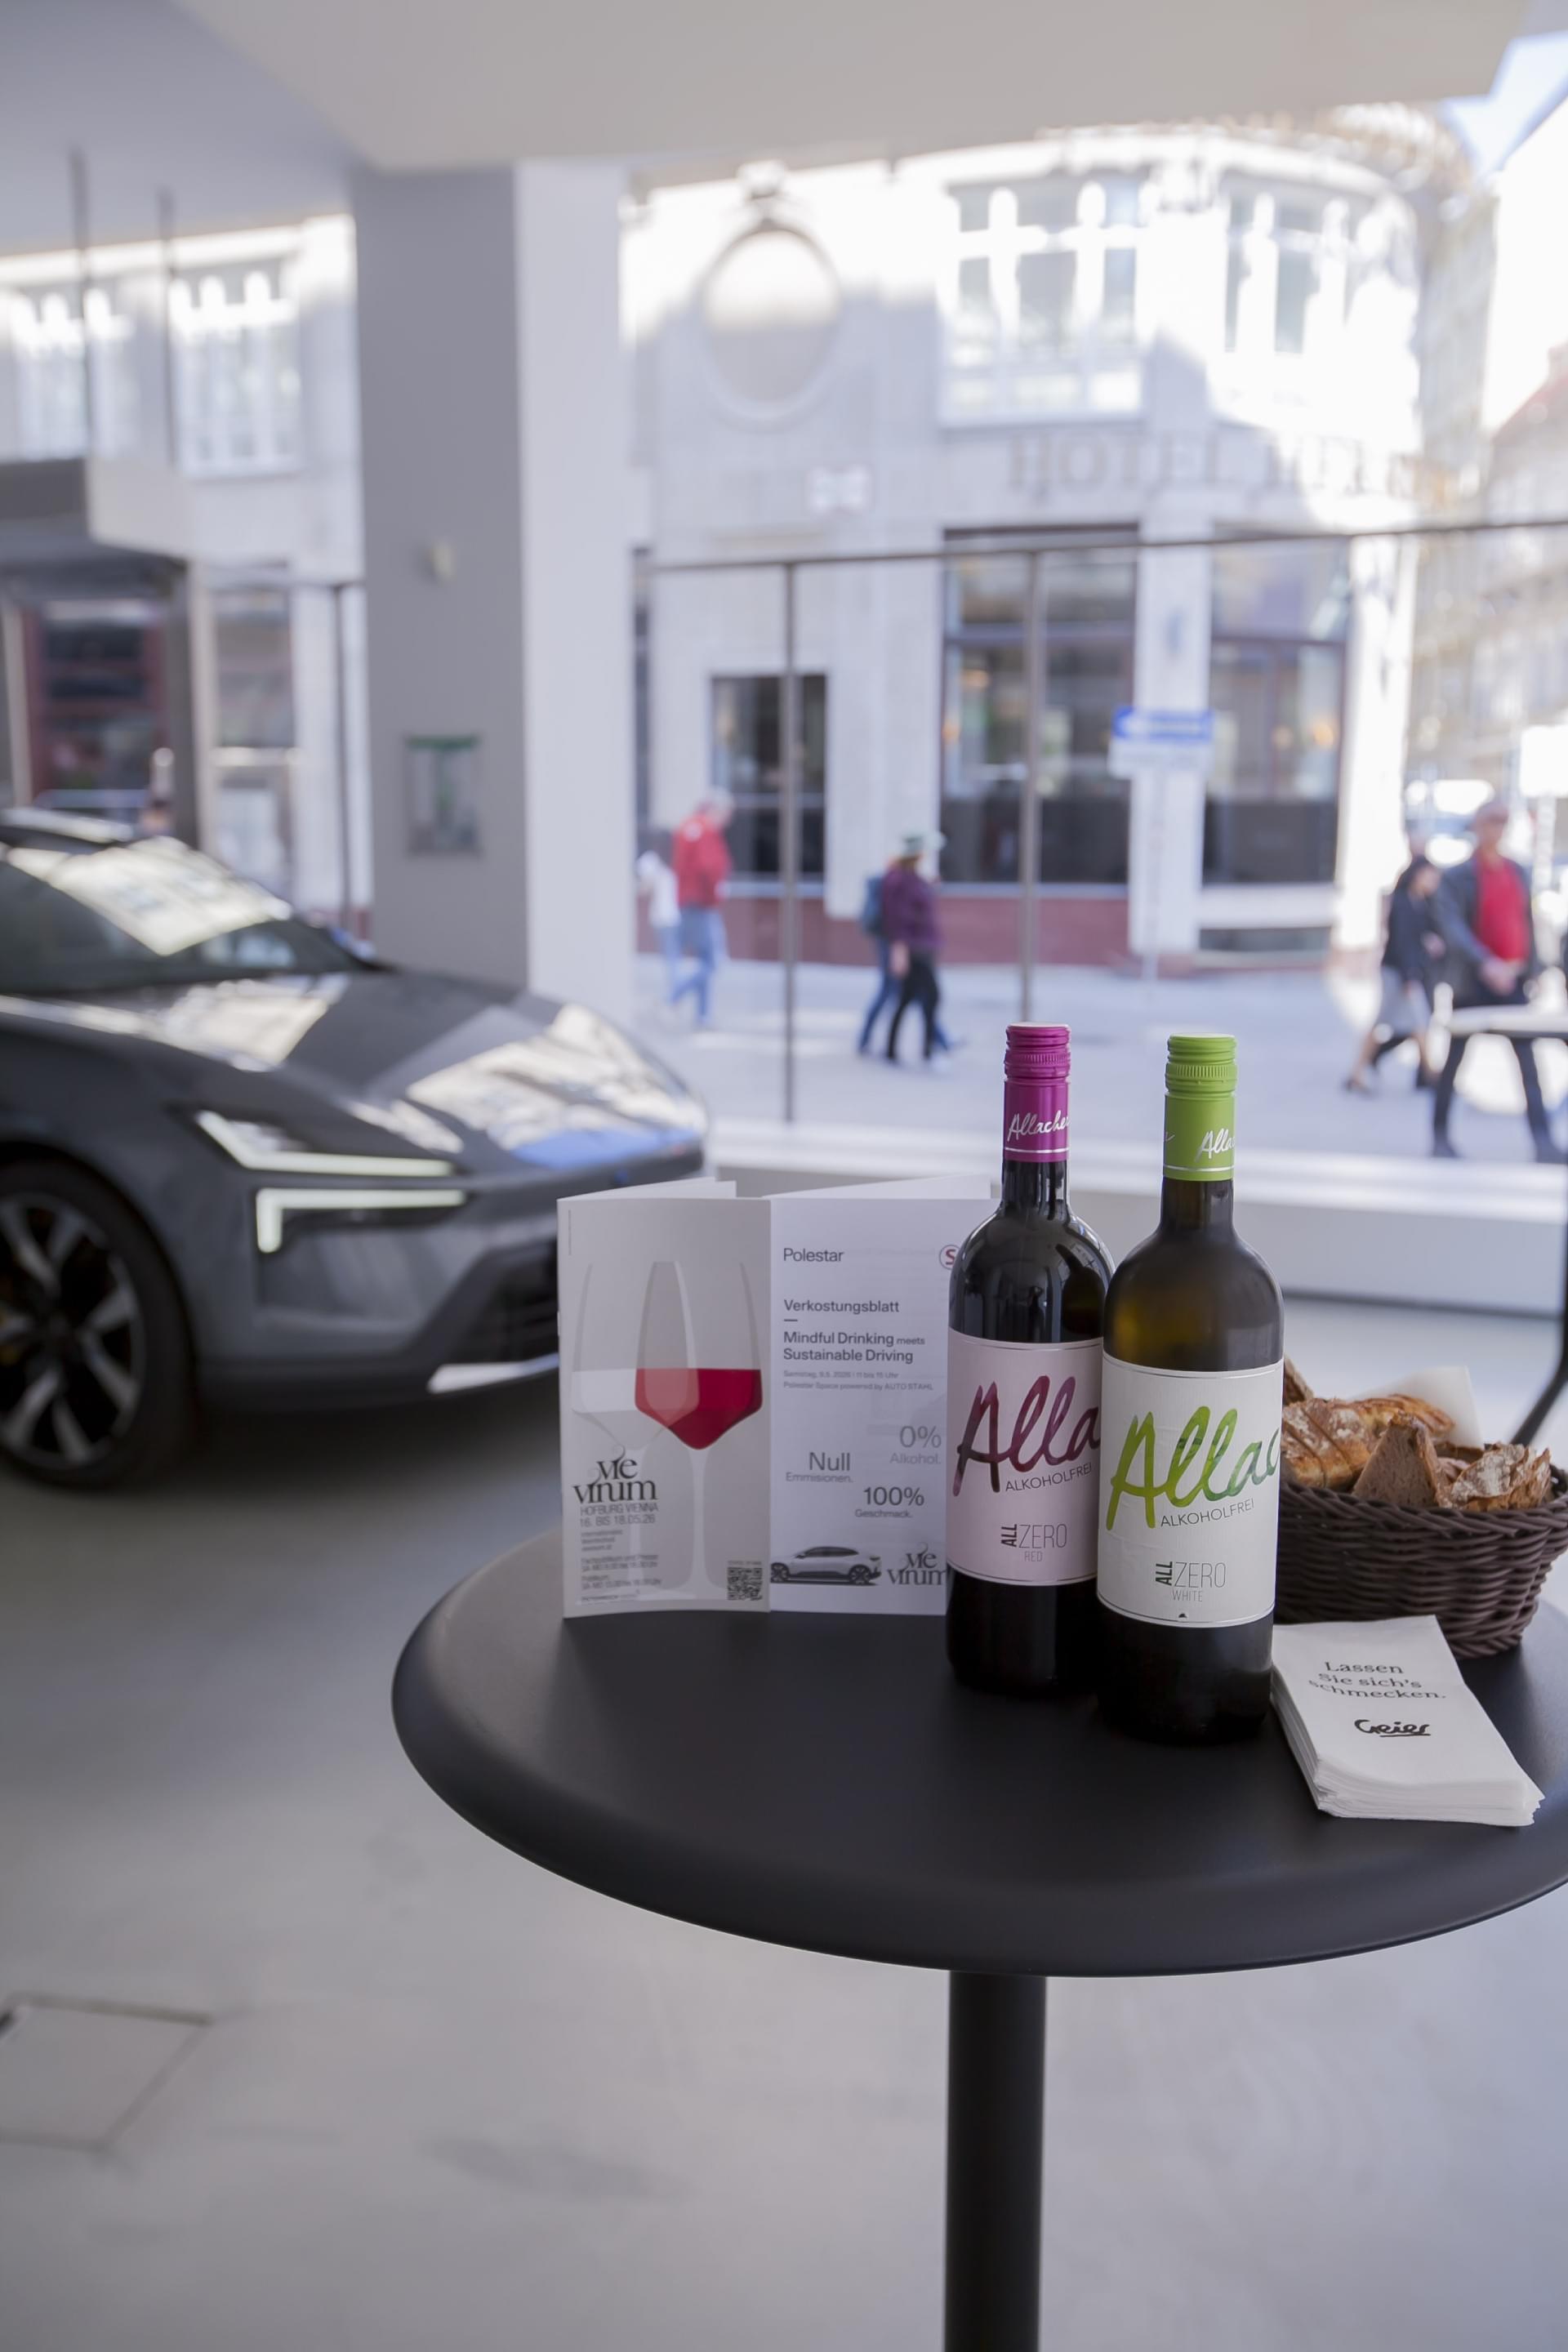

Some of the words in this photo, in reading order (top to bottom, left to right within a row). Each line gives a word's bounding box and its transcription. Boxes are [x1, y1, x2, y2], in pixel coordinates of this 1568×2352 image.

[783, 1248, 845, 1263] Polestar
[783, 1299, 900, 1315] Verkostungsblatt
[783, 1331, 835, 1344] Mindful
[838, 1332, 894, 1348] Drinking
[896, 1337, 925, 1345] meets
[783, 1348, 862, 1361] Sustainable
[866, 1349, 914, 1365] Driving
[899, 1426, 942, 1448] 0%
[809, 1452, 850, 1471] Null
[889, 1453, 941, 1464] Alkohol.
[1005, 1462, 1092, 1492] ALKOHOLFREI
[863, 1486, 924, 1506] 100%
[855, 1509, 913, 1518] Geschmack.
[1160, 1499, 1254, 1527] ALKOHOLFREI
[1001, 1523, 1018, 1548] ALL
[1018, 1524, 1067, 1549] ZERO
[1024, 1551, 1043, 1562] RED
[1155, 1561, 1173, 1586] ALL
[1174, 1561, 1227, 1588] ZERO
[1172, 1589, 1203, 1602] WHITE
[1325, 1661, 1404, 1674] Lassen
[1318, 1673, 1352, 1685] Sie
[1308, 1680, 1446, 1699] schmecken.
